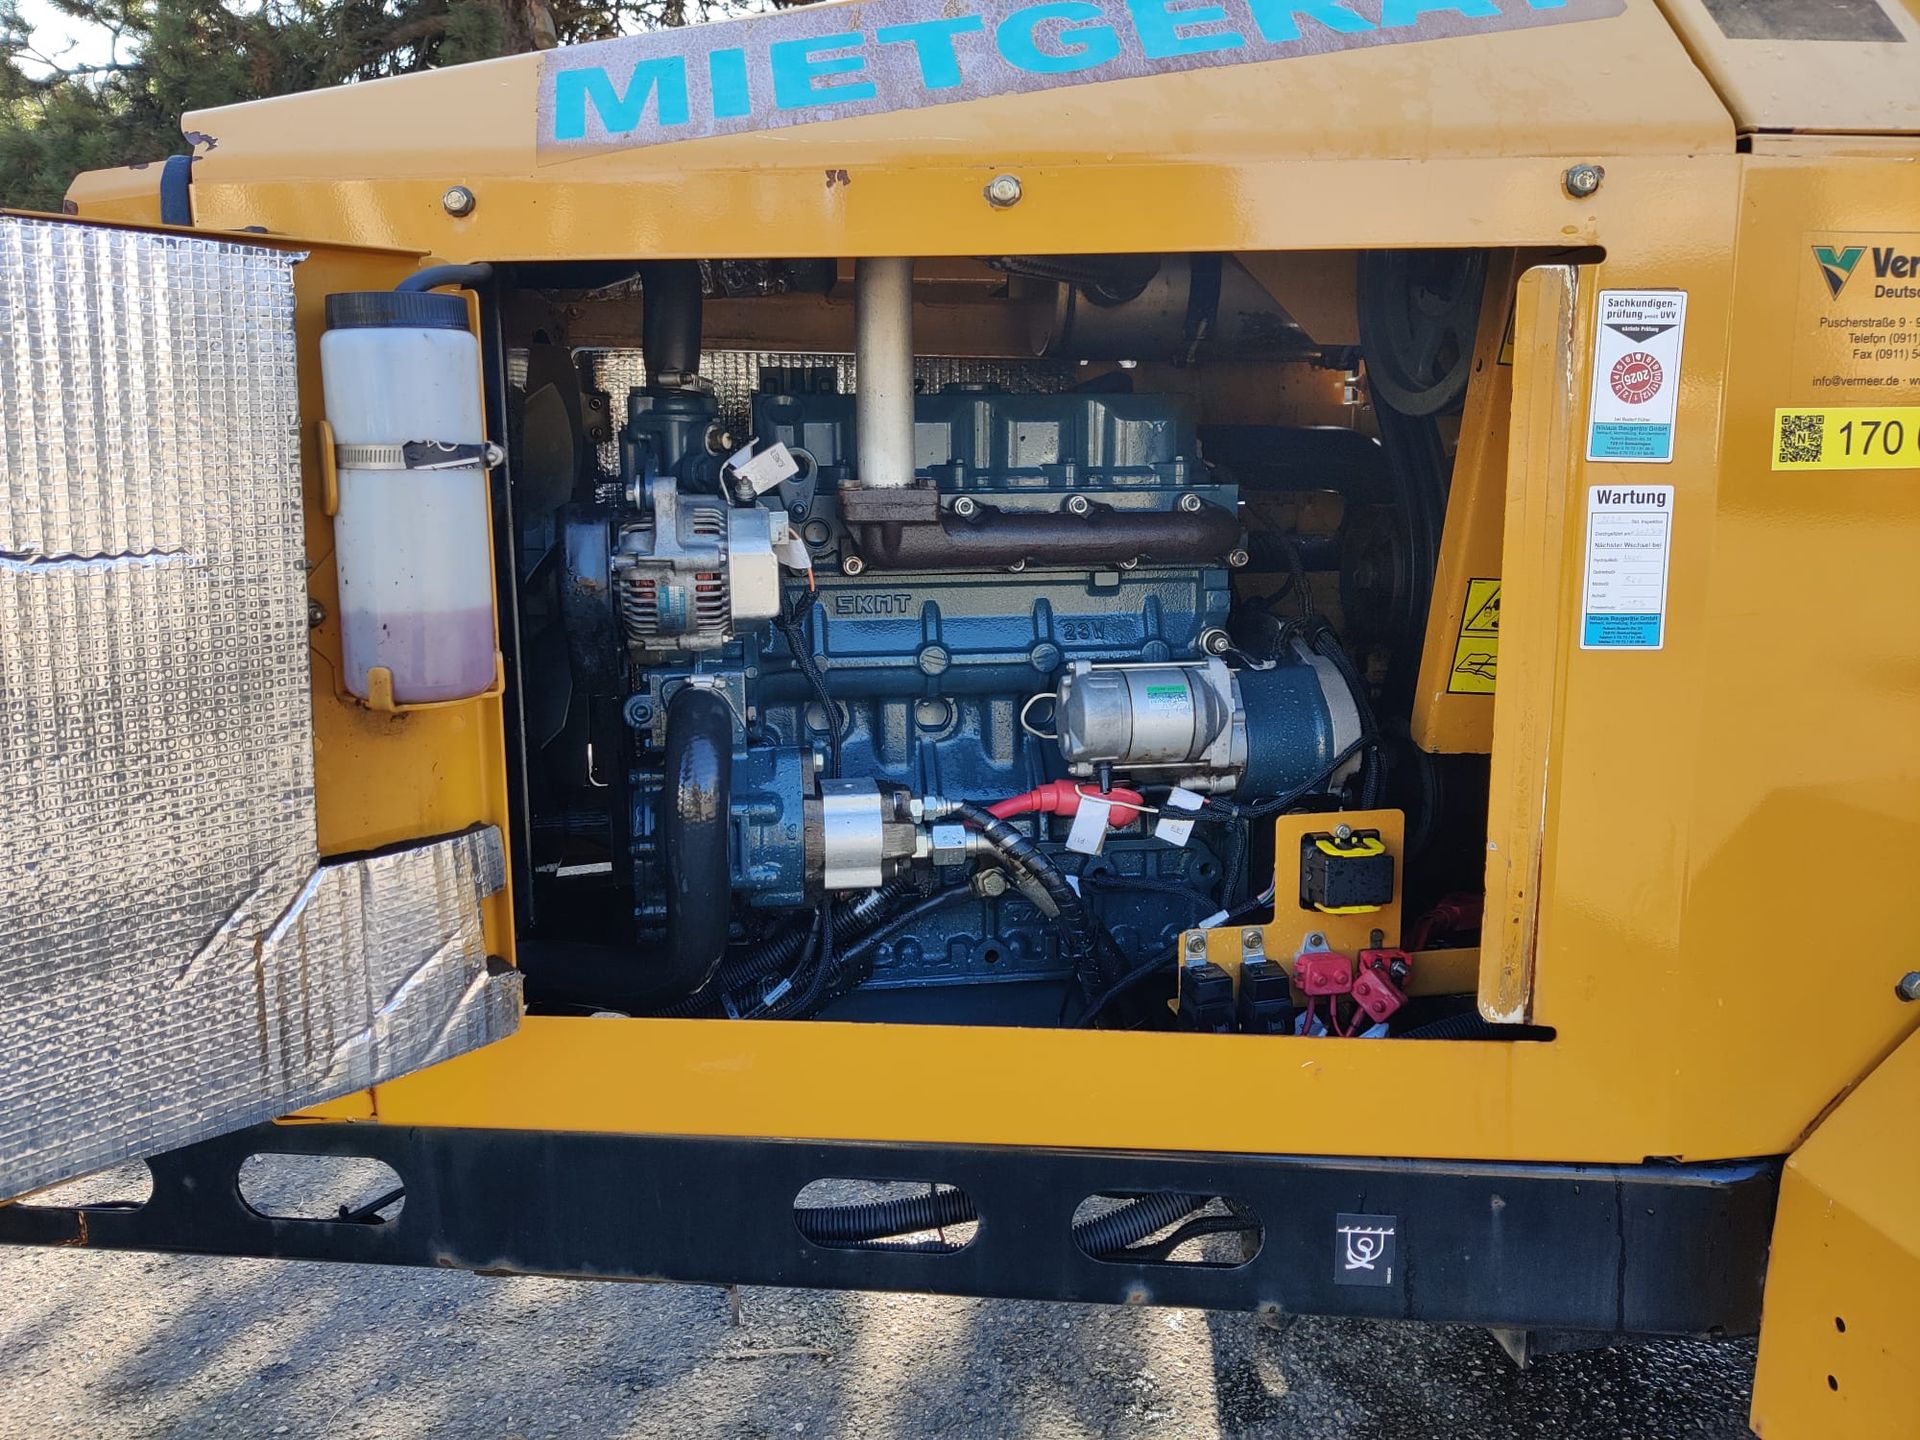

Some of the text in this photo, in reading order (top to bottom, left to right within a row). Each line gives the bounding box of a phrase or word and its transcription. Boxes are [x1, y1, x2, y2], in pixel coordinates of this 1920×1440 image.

[1607, 298, 1677, 309] Sachkundigen-
[1607, 309, 1643, 320] prüfung
[1660, 311, 1676, 319] UVV
[1819, 317, 1896, 328] Puscherstraße
[1899, 317, 1906, 328] 9
[1848, 333, 1886, 344] Telefon
[1853, 349, 1872, 360] Fax
[1875, 349, 1909, 360] (0911)
[1624, 369, 1649, 385] 2025
[1812, 375, 1899, 386] info@vermeer.de
[1839, 420, 1904, 455] 170
[1597, 489, 1666, 508] Wartung
